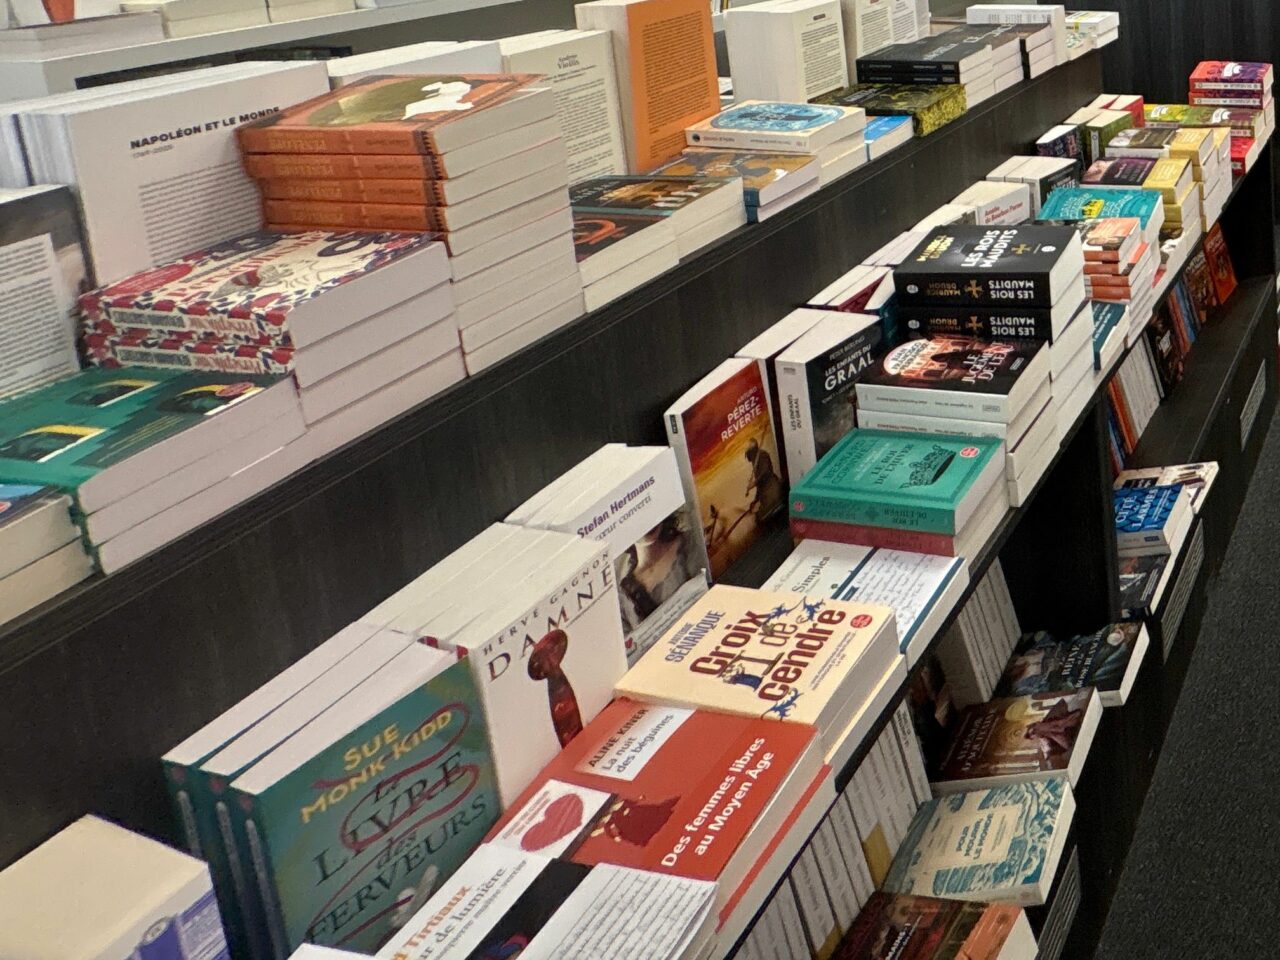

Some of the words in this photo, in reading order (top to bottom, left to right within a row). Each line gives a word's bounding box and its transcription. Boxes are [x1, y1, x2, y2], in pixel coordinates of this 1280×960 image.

[130, 125, 202, 149] NAPOLÉON
[205, 120, 220, 132] ET
[222, 116, 237, 128] LE
[961, 252, 981, 268] LES
[974, 229, 1001, 253] ROIS
[979, 229, 1019, 269] MAUDITS
[927, 288, 961, 297] MAURICE
[929, 281, 957, 289] DRUON
[988, 280, 1034, 289] MAUDITS
[990, 290, 1015, 299] ROIS
[1018, 290, 1034, 299] LES
[930, 318, 957, 326] DRUON
[989, 316, 1035, 326] MAUDITS
[991, 326, 1015, 336] ROIS
[1018, 326, 1035, 336] LES
[824, 364, 837, 378] LES
[836, 350, 861, 371] ENFANTS
[861, 344, 872, 357] DU
[824, 351, 875, 391] GRAAL
[963, 353, 981, 367] LE
[978, 367, 997, 383] DE
[721, 404, 762, 442] REVERTE
[727, 395, 759, 425] PÉREZ-
[786, 394, 795, 421] ENFANTS
[793, 397, 801, 420] GRAAL
[870, 460, 886, 476] LE
[882, 449, 899, 465] ROI
[875, 470, 891, 486] DE
[576, 508, 611, 539] Stefan
[609, 475, 656, 514] Hertmans
[618, 494, 652, 524] converti
[1132, 488, 1159, 528] LARMES
[550, 550, 609, 605] GAGNON
[791, 555, 831, 594] Simples
[487, 562, 614, 683] DAMNÉ
[665, 609, 726, 663] SÉNANQUE
[759, 621, 799, 648] de
[689, 609, 769, 676] Croix
[758, 608, 847, 702] cendre
[343, 722, 400, 772] SUE
[588, 731, 619, 768] ALINE
[617, 708, 649, 738] KINER
[601, 754, 620, 772] La
[618, 736, 638, 757] nuit
[616, 751, 636, 774] des
[631, 713, 676, 753] béguines
[301, 759, 387, 824] MONK
[391, 710, 453, 761] KIDD
[373, 778, 401, 805] Le
[661, 835, 691, 867] Des
[685, 774, 736, 832] femmes
[728, 737, 766, 773] libres
[694, 835, 715, 856] au
[708, 781, 753, 832] Moyen
[745, 751, 775, 780] Âge
[313, 751, 463, 887] LIVRE
[303, 793, 488, 945] FERVEURS
[377, 830, 418, 870] des
[405, 884, 471, 948] Tirtiaux
[436, 923, 453, 944] de
[451, 867, 507, 925] lumière
